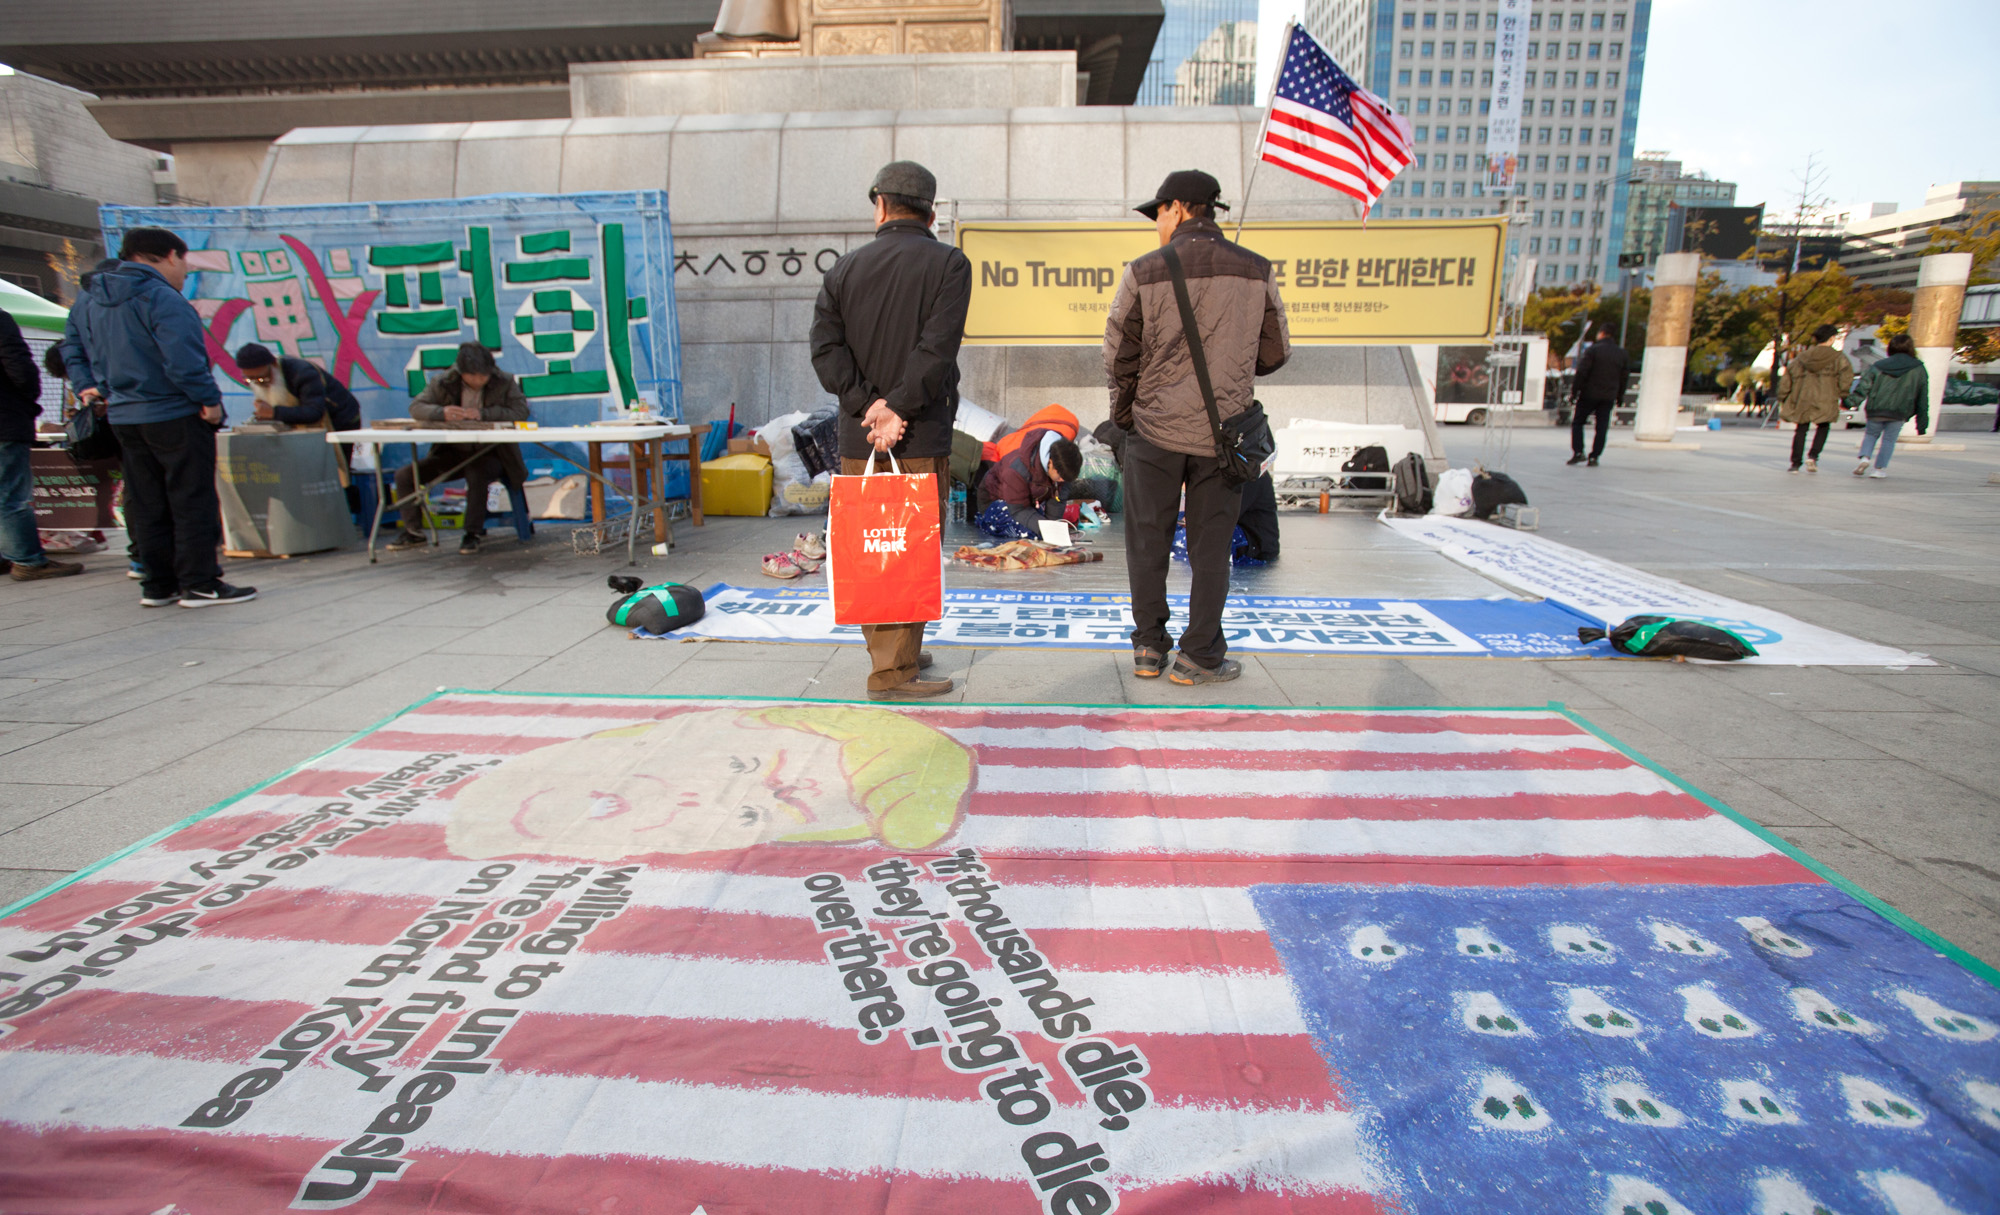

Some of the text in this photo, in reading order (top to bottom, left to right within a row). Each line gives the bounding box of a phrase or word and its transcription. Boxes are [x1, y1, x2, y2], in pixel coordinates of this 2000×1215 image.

[981, 261, 1114, 294] No Trump
[1295, 257, 1350, 288] 방한
[1356, 257, 1477, 288] 반대한다!
[366, 223, 649, 411] 평화
[1068, 302, 1112, 313] 대북제재
[863, 527, 907, 538] LOTTE
[863, 539, 907, 553] Mart
[956, 622, 1070, 638] 불허
[1016, 607, 1123, 622] 탄핵
[346, 753, 458, 801] totally
[367, 787, 440, 817] will
[189, 801, 354, 881] destroy
[267, 817, 389, 871] have
[199, 873, 277, 909] no
[804, 873, 859, 930] over
[428, 920, 522, 984] and
[178, 863, 515, 1128] on North Korea
[945, 875, 1096, 1040] thousands
[1064, 1041, 1147, 1131] die,
[300, 866, 641, 1202] willing to unleash
[868, 859, 1112, 1215] they're going to die
